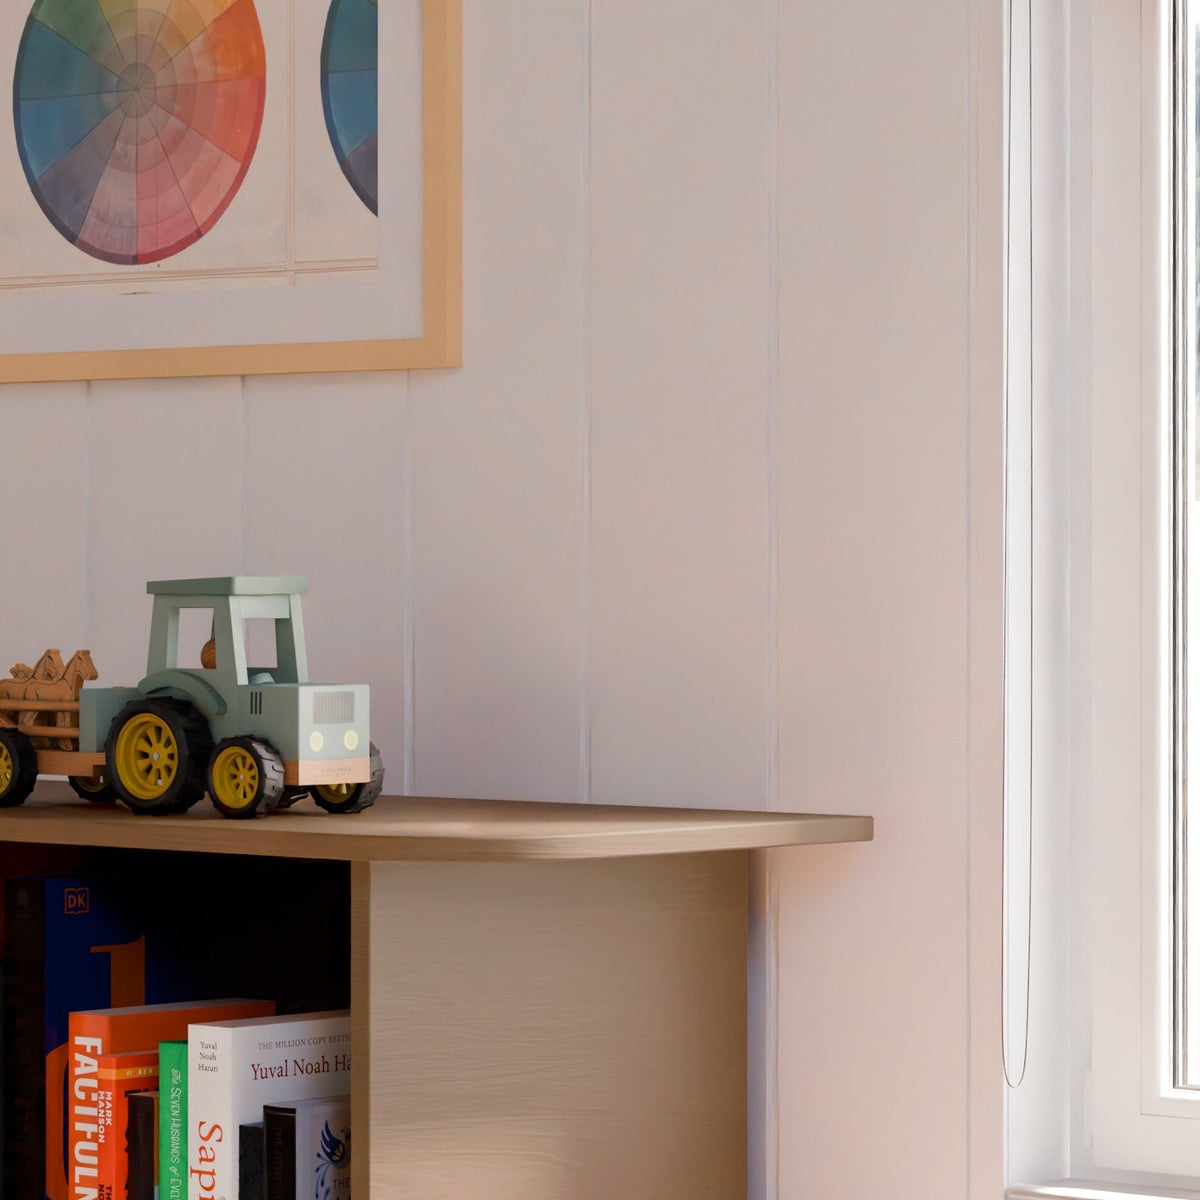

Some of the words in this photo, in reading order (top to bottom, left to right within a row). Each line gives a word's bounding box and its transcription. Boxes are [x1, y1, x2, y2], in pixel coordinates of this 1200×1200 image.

[67, 893, 87, 909] DK
[200, 1041, 218, 1050] Yuval
[258, 1042, 273, 1050] THE
[274, 1038, 306, 1049] MILLION
[307, 1036, 327, 1046] COPY
[199, 1052, 217, 1061] Noah
[198, 1063, 219, 1072] Harari
[251, 1059, 289, 1081] Yuval
[293, 1055, 330, 1077] Noah
[98, 1090, 106, 1143] MANSON
[332, 1178, 351, 1190] THE
